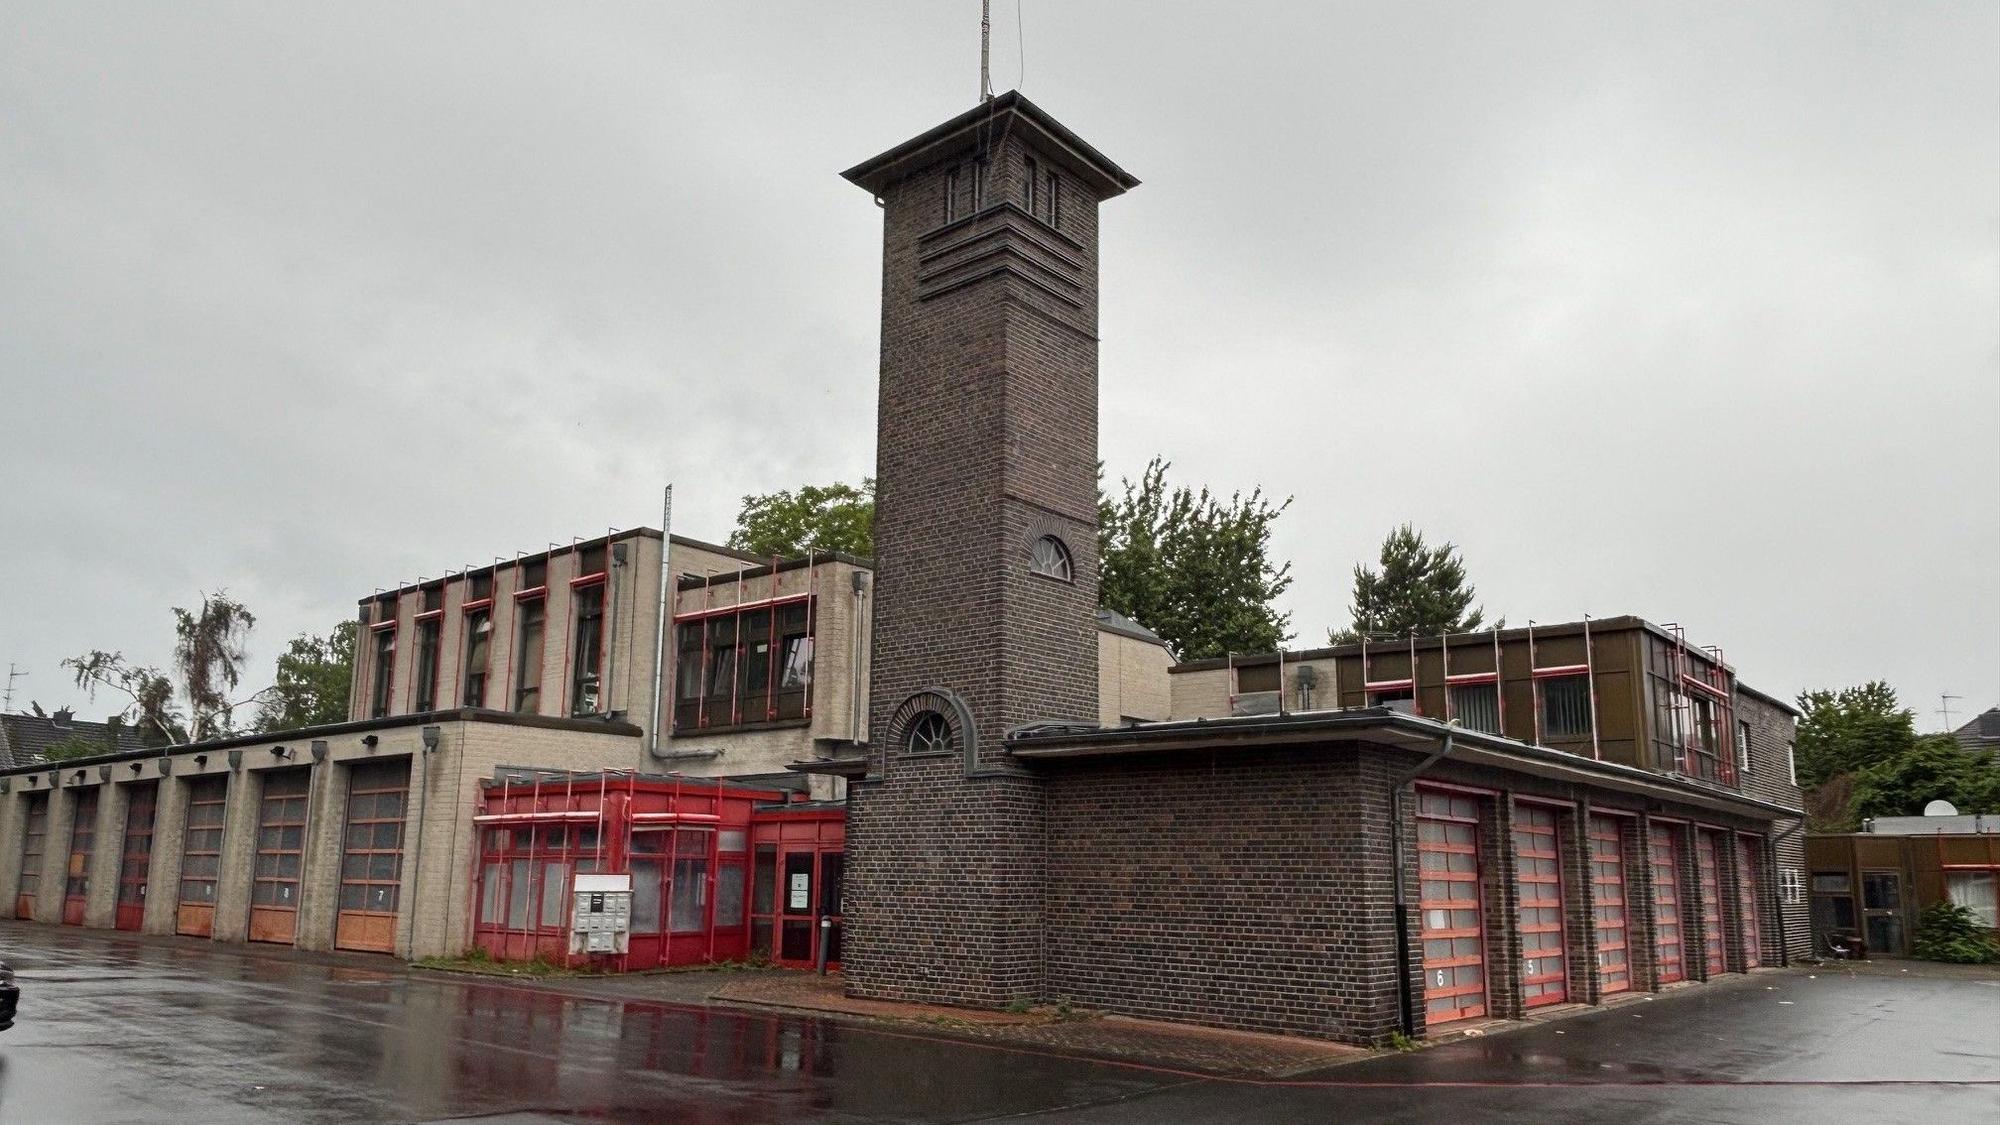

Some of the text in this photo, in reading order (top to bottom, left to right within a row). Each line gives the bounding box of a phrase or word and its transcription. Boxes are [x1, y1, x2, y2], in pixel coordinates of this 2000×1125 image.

[378, 890, 384, 901] 7
[1528, 959, 1534, 975] 5
[1436, 969, 1444, 987] 6
